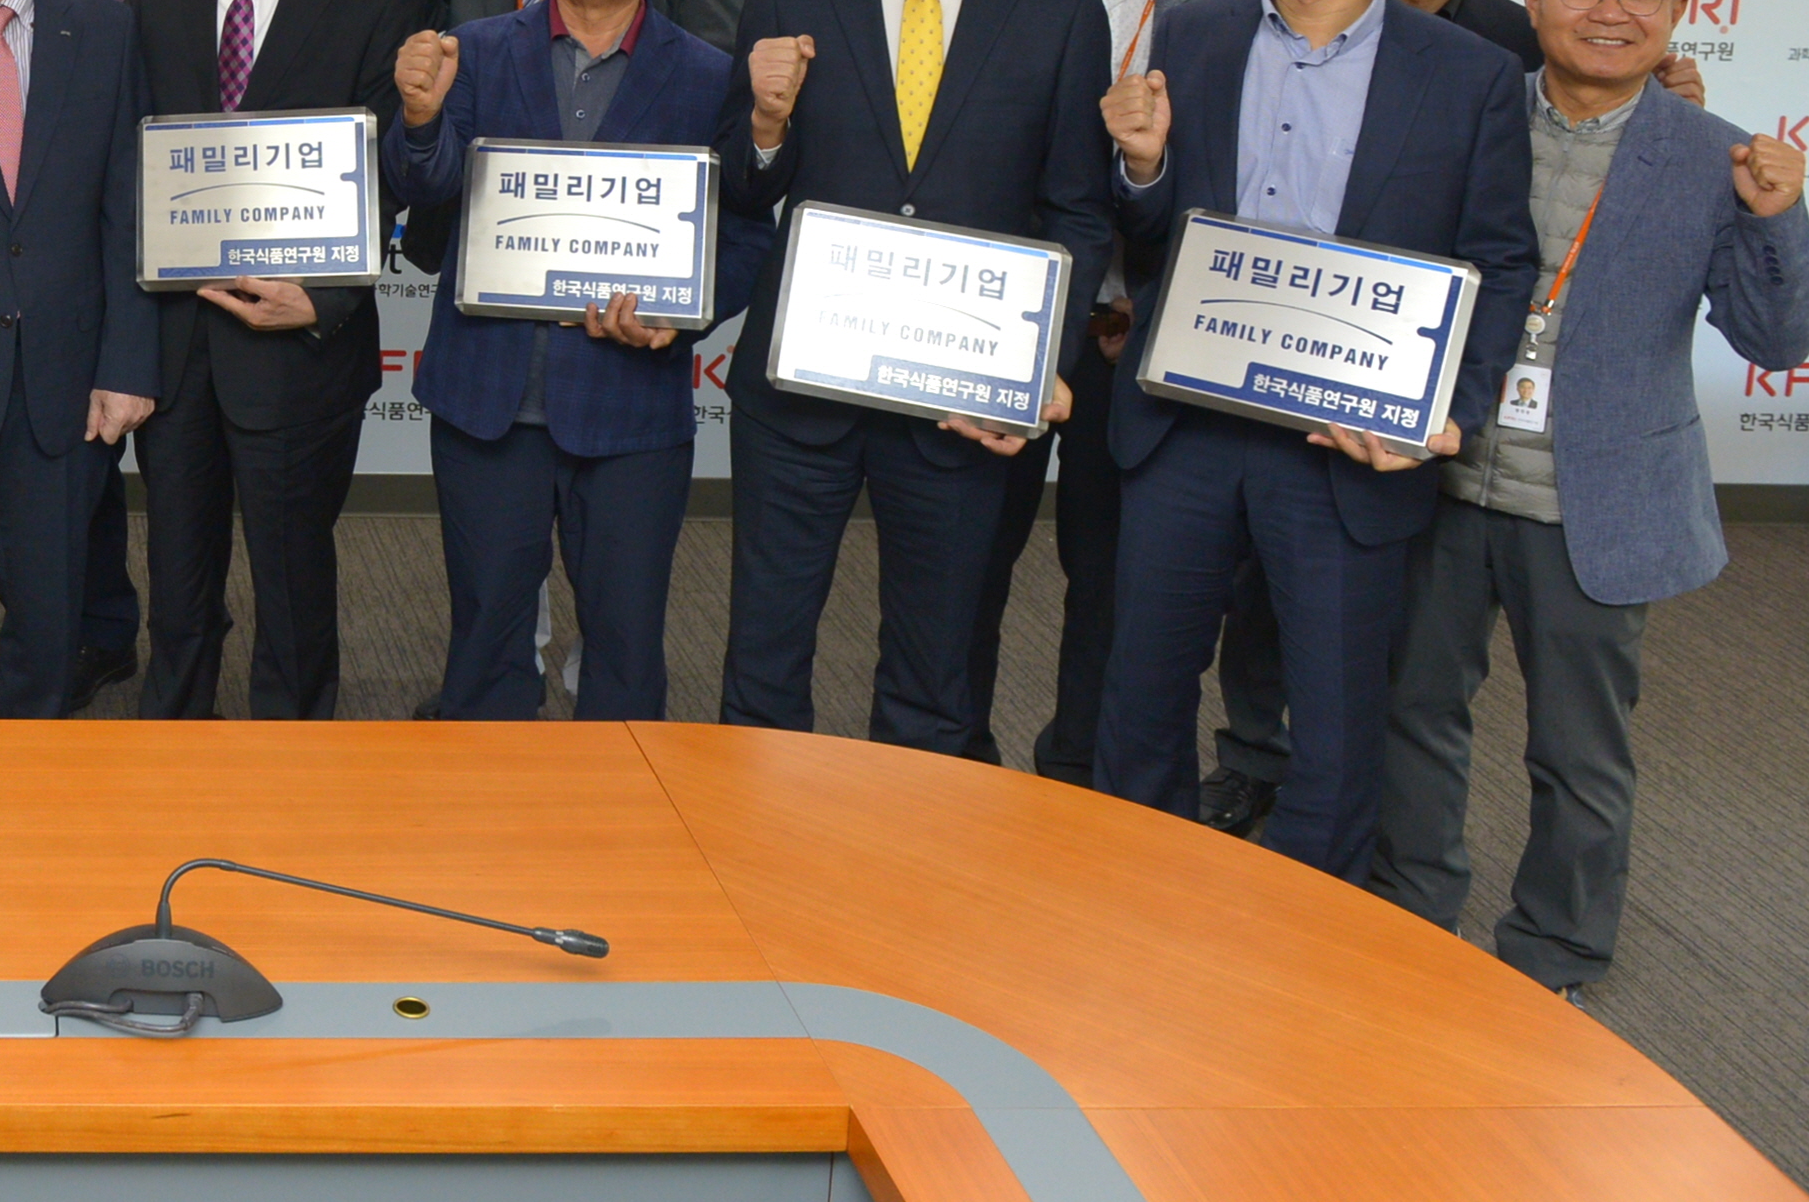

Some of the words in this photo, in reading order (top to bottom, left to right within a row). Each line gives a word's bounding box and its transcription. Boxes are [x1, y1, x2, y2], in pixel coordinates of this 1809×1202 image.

[169, 141, 324, 173] 패밀리기업
[499, 171, 662, 205] 패밀리기업
[170, 208, 234, 225] FAMILY
[241, 206, 325, 223] COMPANY
[228, 247, 326, 265] 한국식품연구원
[331, 245, 360, 264] 지정
[495, 235, 560, 252] FAMILY
[569, 239, 660, 258] COMPANY
[829, 241, 1008, 301] 패밀리기업
[1209, 249, 1405, 314] 패밀리기업
[662, 285, 692, 304] 지정
[819, 310, 889, 335] FAMILY
[900, 325, 999, 358] COMPANY
[1194, 313, 1272, 344] FAMILY
[1281, 333, 1389, 371] COMPANY
[877, 364, 992, 403] 한국식품연구원
[995, 388, 1031, 411] 지정
[1253, 373, 1377, 416] 한국식품연구원
[1380, 405, 1420, 428] 지정
[140, 958, 215, 979] BOSCH
